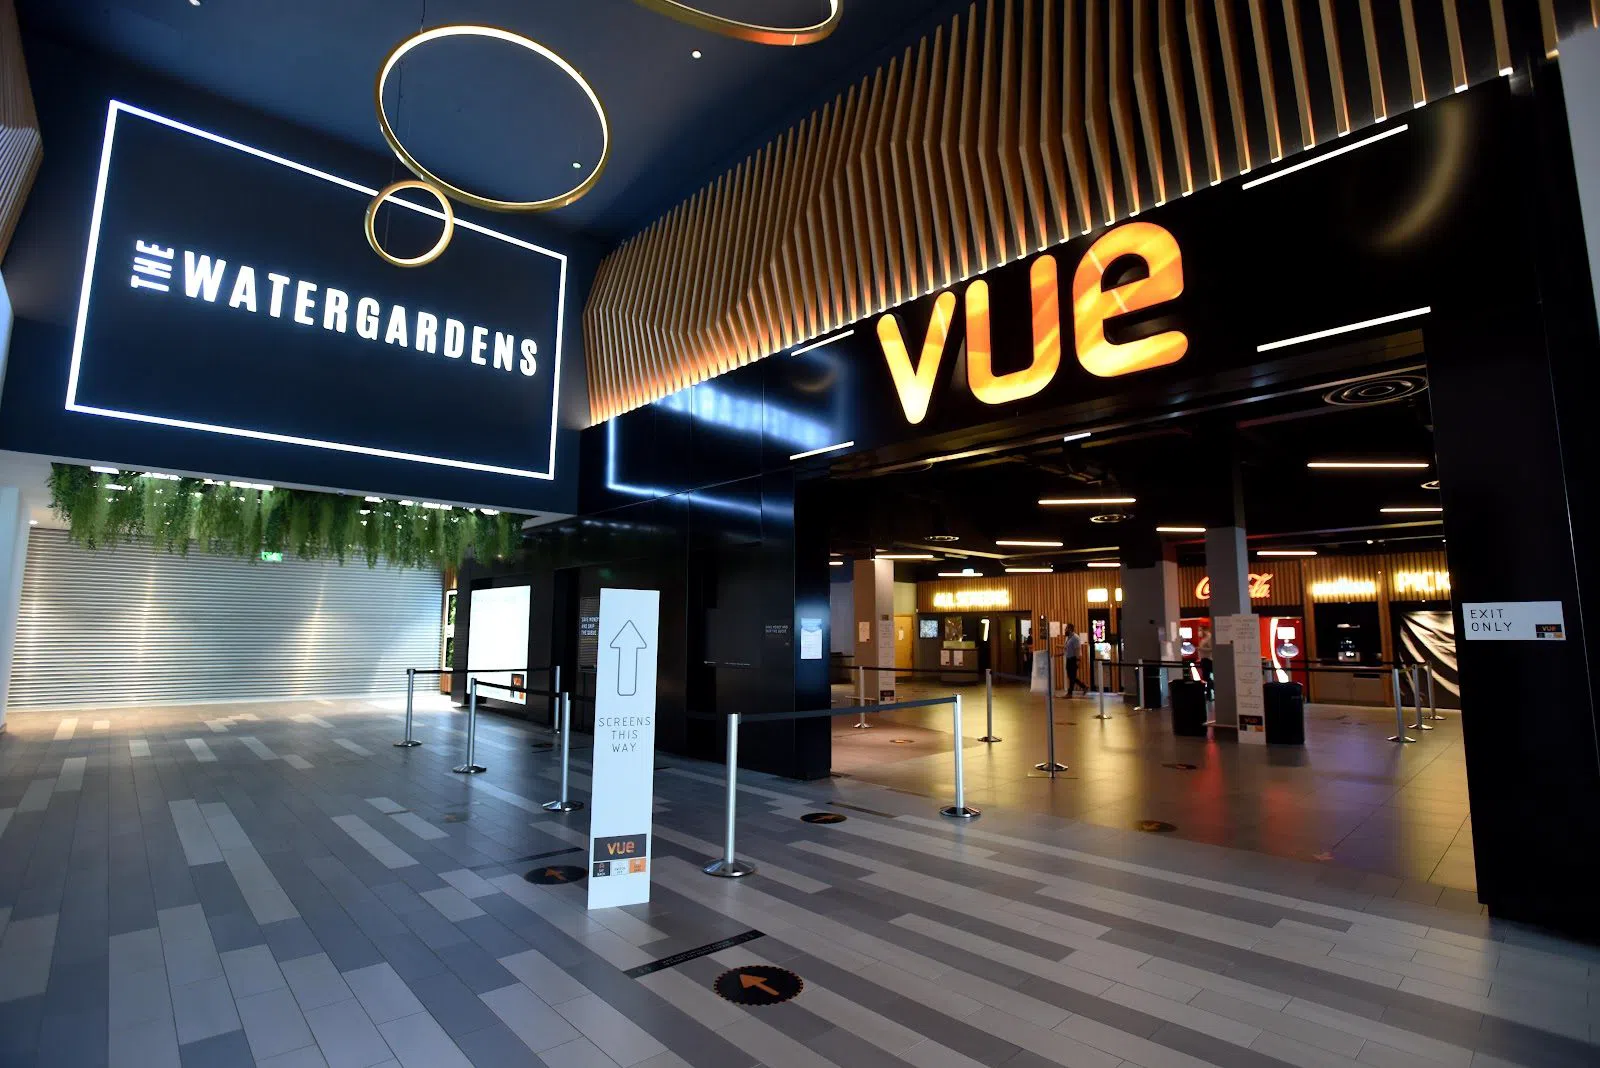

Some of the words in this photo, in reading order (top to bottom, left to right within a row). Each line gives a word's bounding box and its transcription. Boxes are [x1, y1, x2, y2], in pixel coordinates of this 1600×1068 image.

[130, 239, 175, 293] THE
[183, 249, 538, 378] WATERGARDENS
[1470, 608, 1503, 619] EXIT
[1471, 622, 1512, 632] ONLY
[598, 716, 651, 727] SCREENS
[612, 729, 639, 740] THIS
[612, 742, 637, 753] WAY
